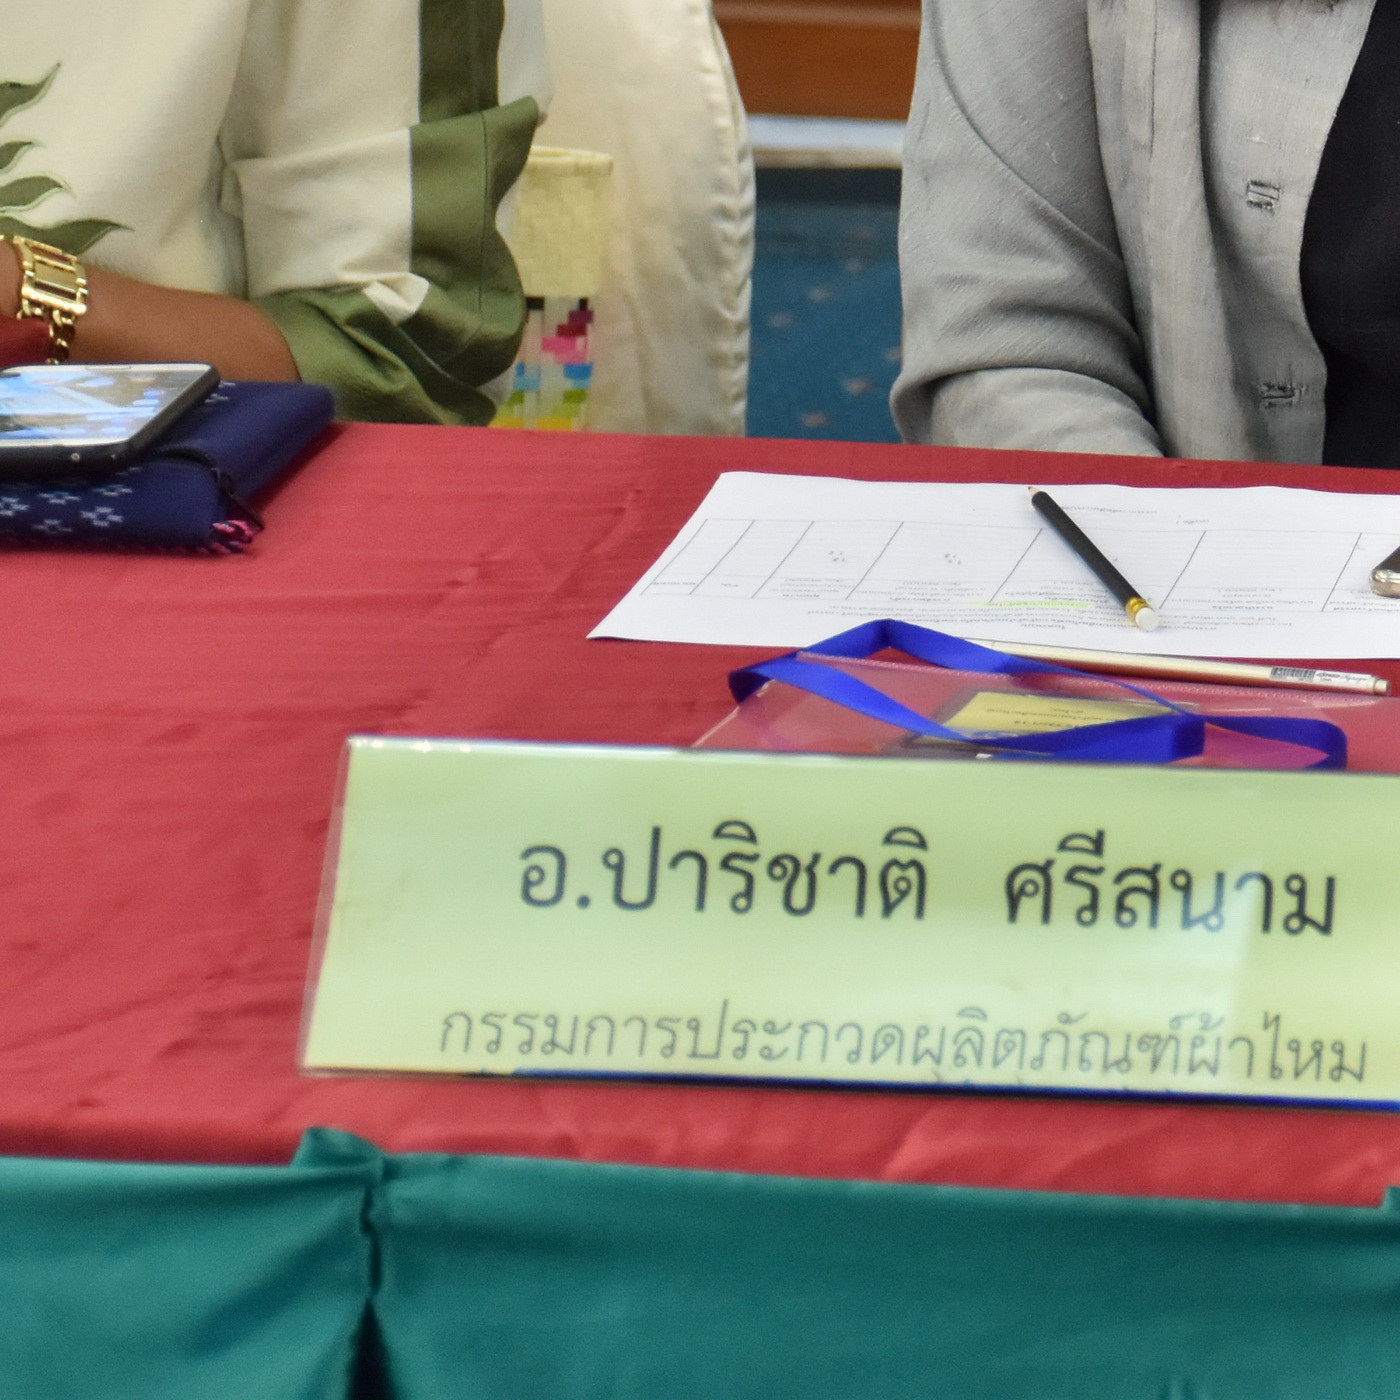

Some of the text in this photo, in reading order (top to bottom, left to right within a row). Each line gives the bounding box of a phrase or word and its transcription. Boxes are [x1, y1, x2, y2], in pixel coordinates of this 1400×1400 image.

[519, 819, 1336, 936] อ.ปาริชาติ ศรีสนาม
[440, 998, 1368, 1083] กรรมการประกวดผลิตภัณฑ์ผ้าไหม
